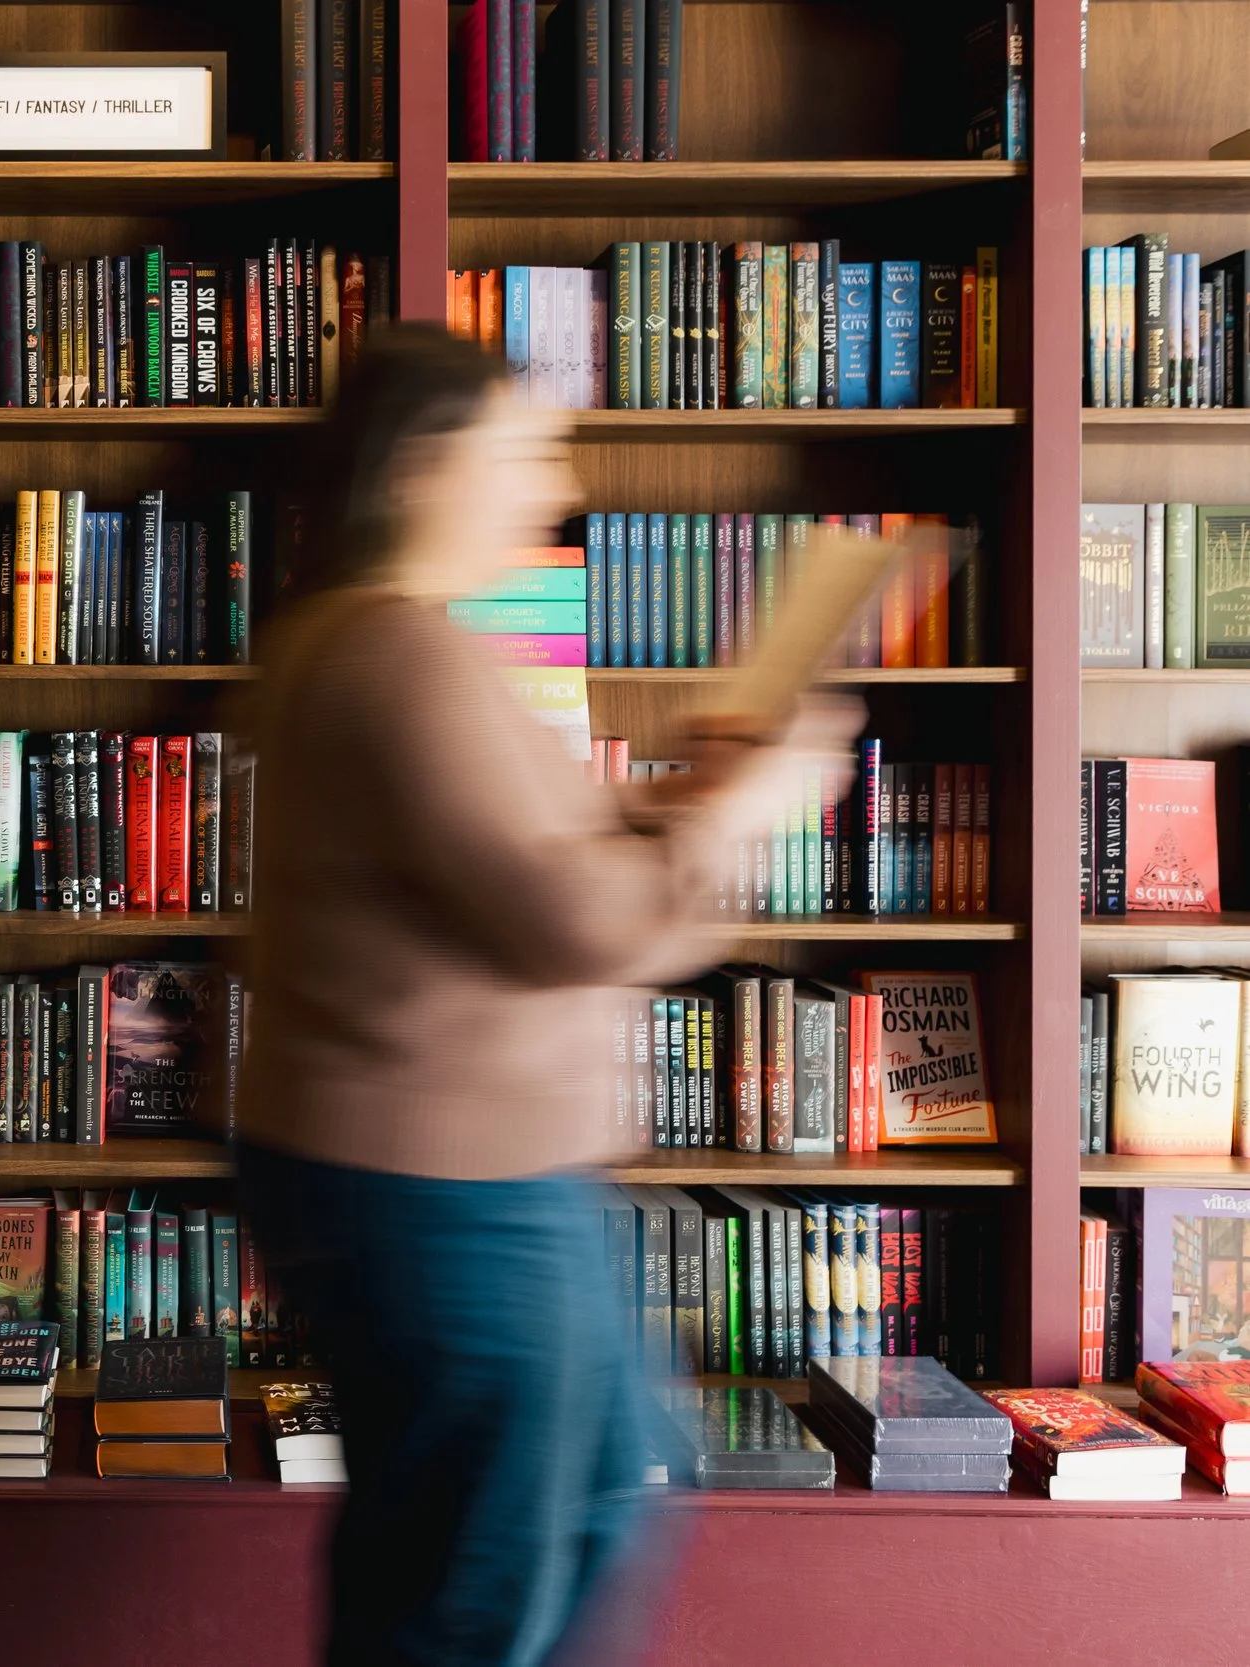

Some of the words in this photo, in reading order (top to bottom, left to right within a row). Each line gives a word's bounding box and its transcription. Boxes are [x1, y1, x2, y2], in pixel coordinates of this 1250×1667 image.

[25, 100, 86, 114] FANTASY
[104, 100, 172, 113] THRILLER
[25, 247, 37, 294] SOMETHING
[306, 248, 314, 263] THE
[146, 252, 160, 294] WHISTLE
[306, 267, 315, 306] GALLERY
[170, 280, 189, 337] CROOKED
[195, 287, 215, 314] SIX
[650, 270, 660, 314] KUANG
[27, 297, 38, 330] WICKED
[196, 318, 215, 333] OF
[147, 311, 161, 356] LINWOOD
[306, 308, 314, 358] ASSISTANT
[147, 358, 161, 399] BARCLAY
[171, 343, 189, 400] KINGDOM
[197, 340, 216, 393] CROWS
[650, 335, 661, 399] KATABASIS
[143, 510, 156, 544] THREE
[142, 546, 155, 603] SHATTERED
[653, 564, 662, 601] THRONE
[42, 593, 50, 609] EXIT
[42, 611, 51, 645] STRATEGY
[142, 605, 154, 639] SOULS
[653, 614, 662, 644] GLASS
[543, 683, 578, 699] PICK
[1106, 797, 1122, 858] SCHWAB
[1135, 887, 1205, 902] SCHWAB
[229, 984, 239, 1011] LISA
[702, 1011, 712, 1024] DO
[702, 1025, 712, 1038] NOT
[883, 1010, 970, 1034] OSMAN
[228, 1012, 239, 1059] JEWELL
[155, 1059, 175, 1067] THE
[703, 1039, 713, 1070] DISTURB
[886, 1051, 913, 1065] The
[1131, 1046, 1222, 1068] FOURTH
[129, 1099, 145, 1107] THE
[152, 1090, 199, 1110] FEW
[902, 1089, 982, 1123] Fortune
[790, 1221, 801, 1244] DEATH
[903, 1232, 922, 1265] HOT
[791, 1247, 801, 1257] ON
[791, 1259, 801, 1276] THE
[791, 1279, 801, 1309] ISLAND
[903, 1272, 921, 1313] WAX
